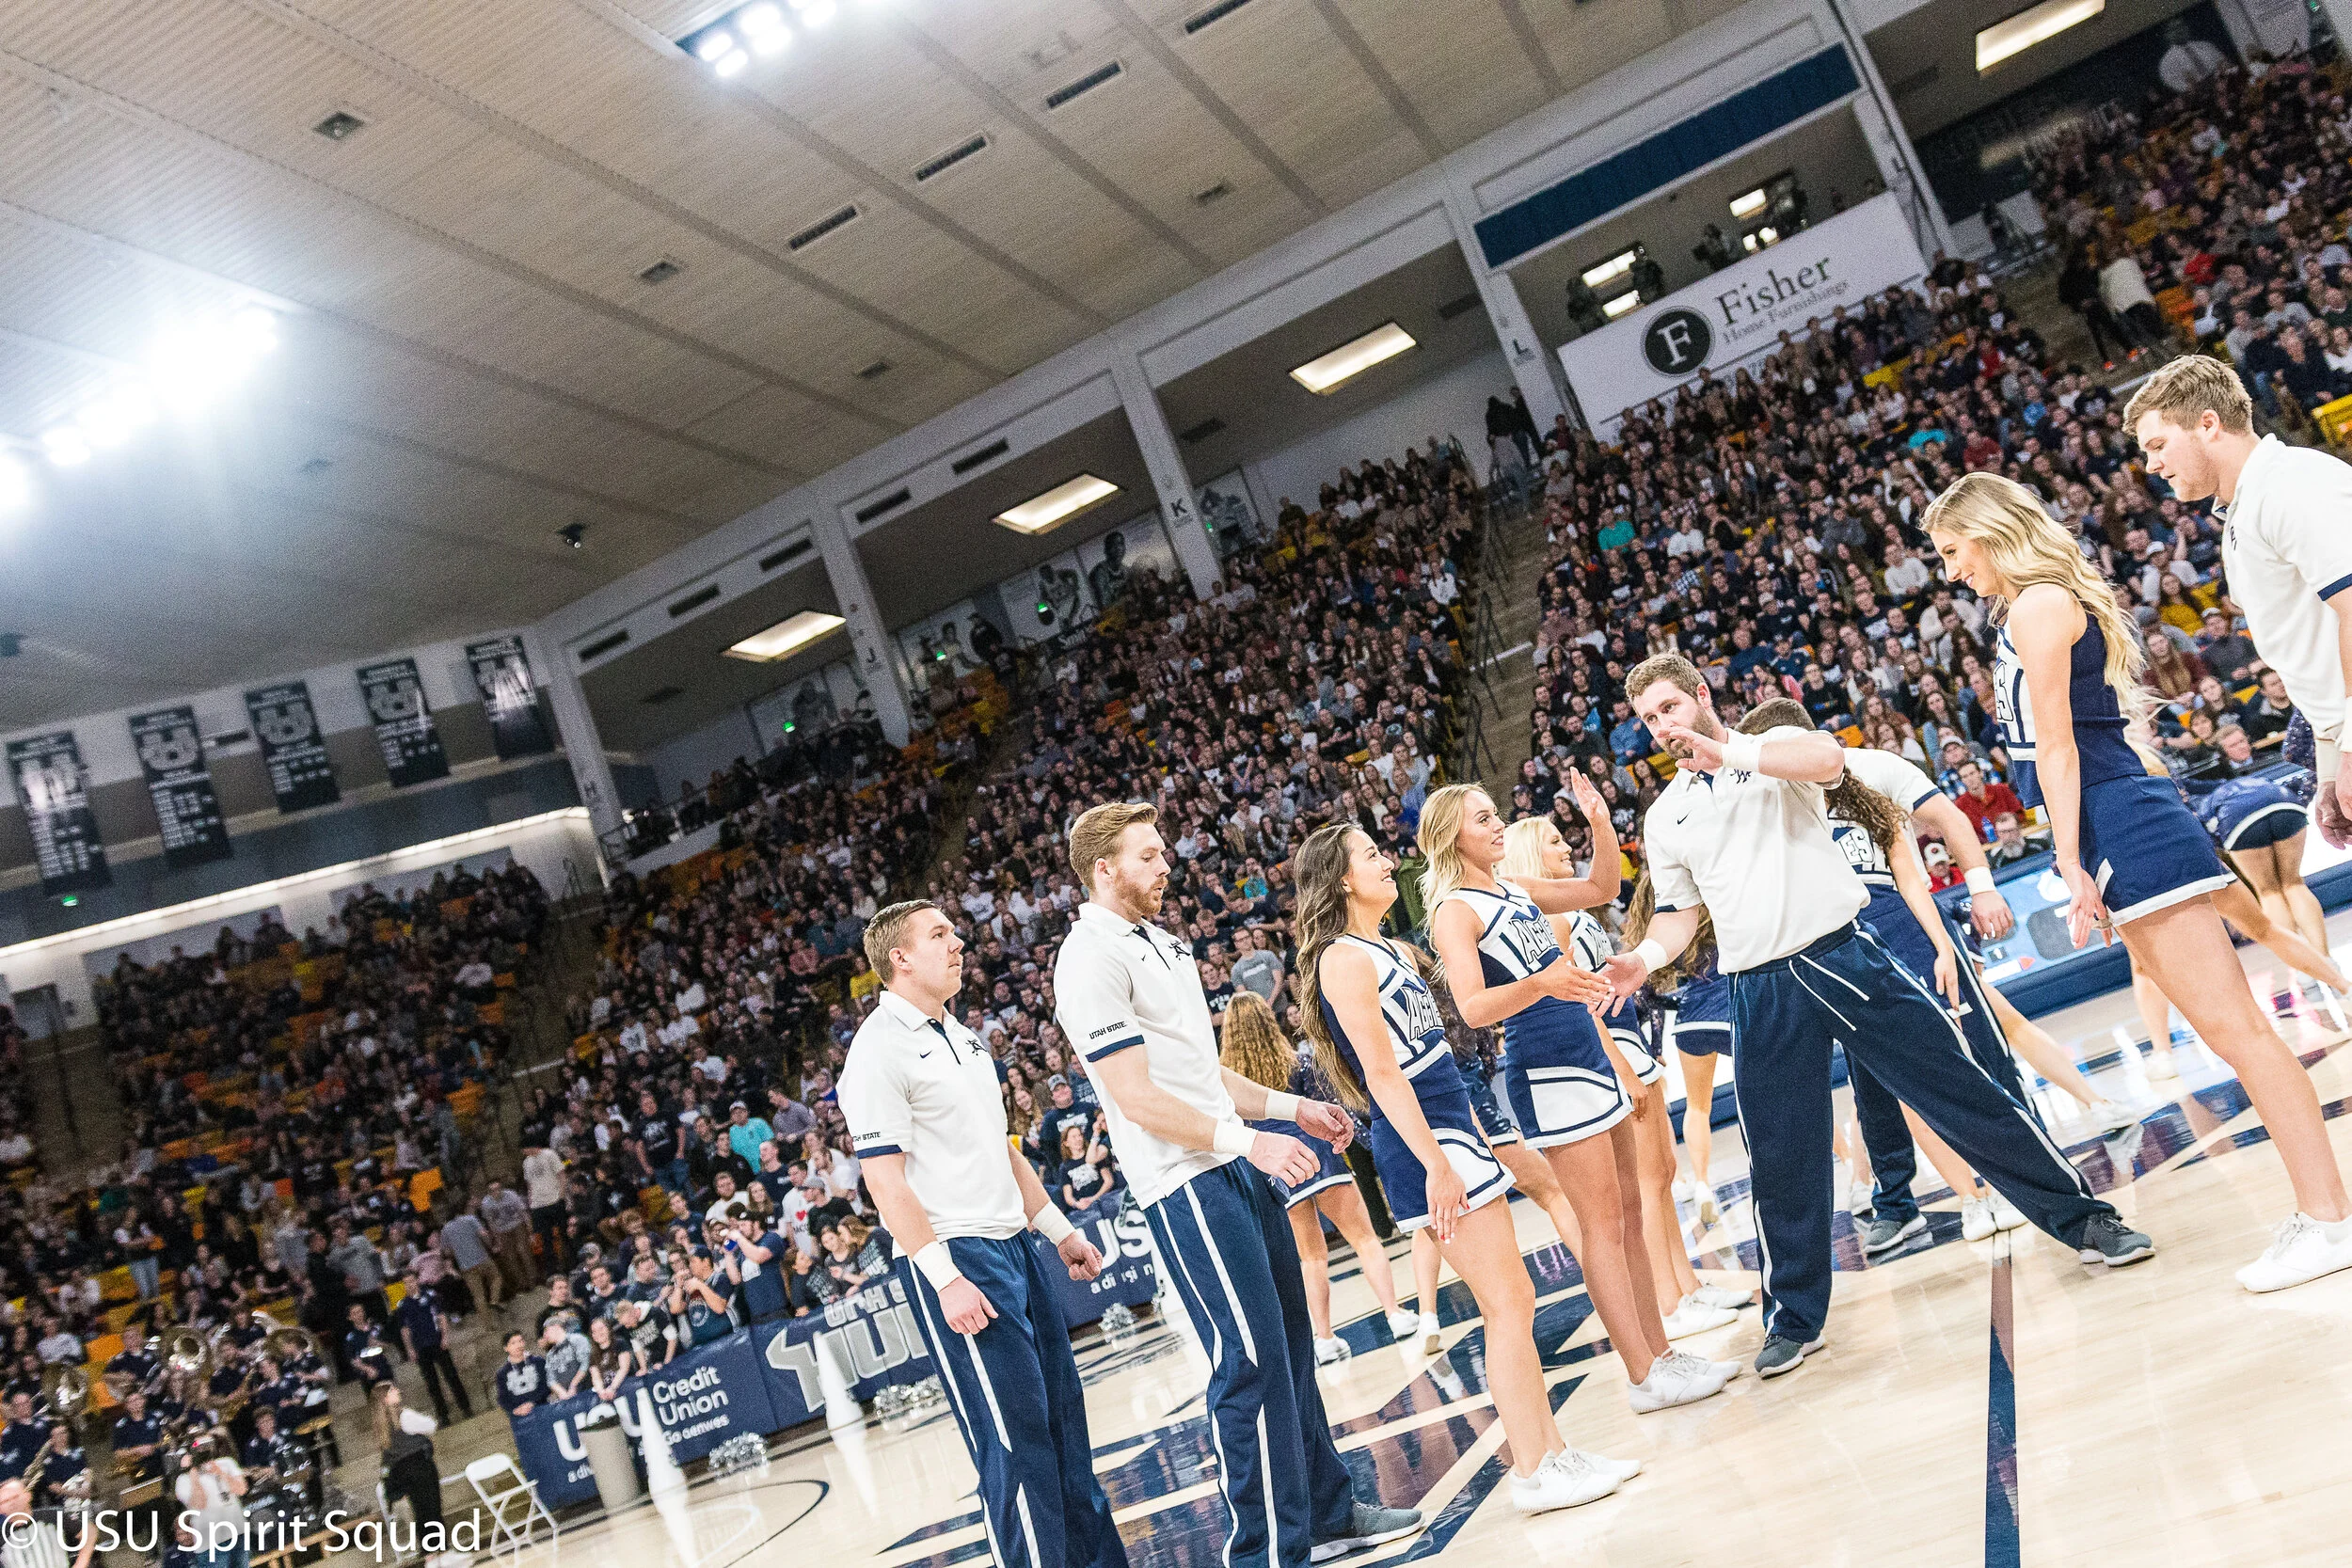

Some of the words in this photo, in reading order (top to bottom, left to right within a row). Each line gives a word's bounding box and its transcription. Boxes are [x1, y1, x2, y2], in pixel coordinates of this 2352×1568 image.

[1715, 256, 1830, 326] Fisher
[1657, 318, 1692, 368] F
[1722, 318, 1767, 345] Home
[1170, 498, 1188, 517] K
[1089, 1027, 1107, 1040] UTAH
[1106, 1021, 1128, 1033] STATE
[862, 1132, 882, 1141] STATE
[653, 1366, 722, 1404] Credit
[658, 1387, 730, 1426] Union
